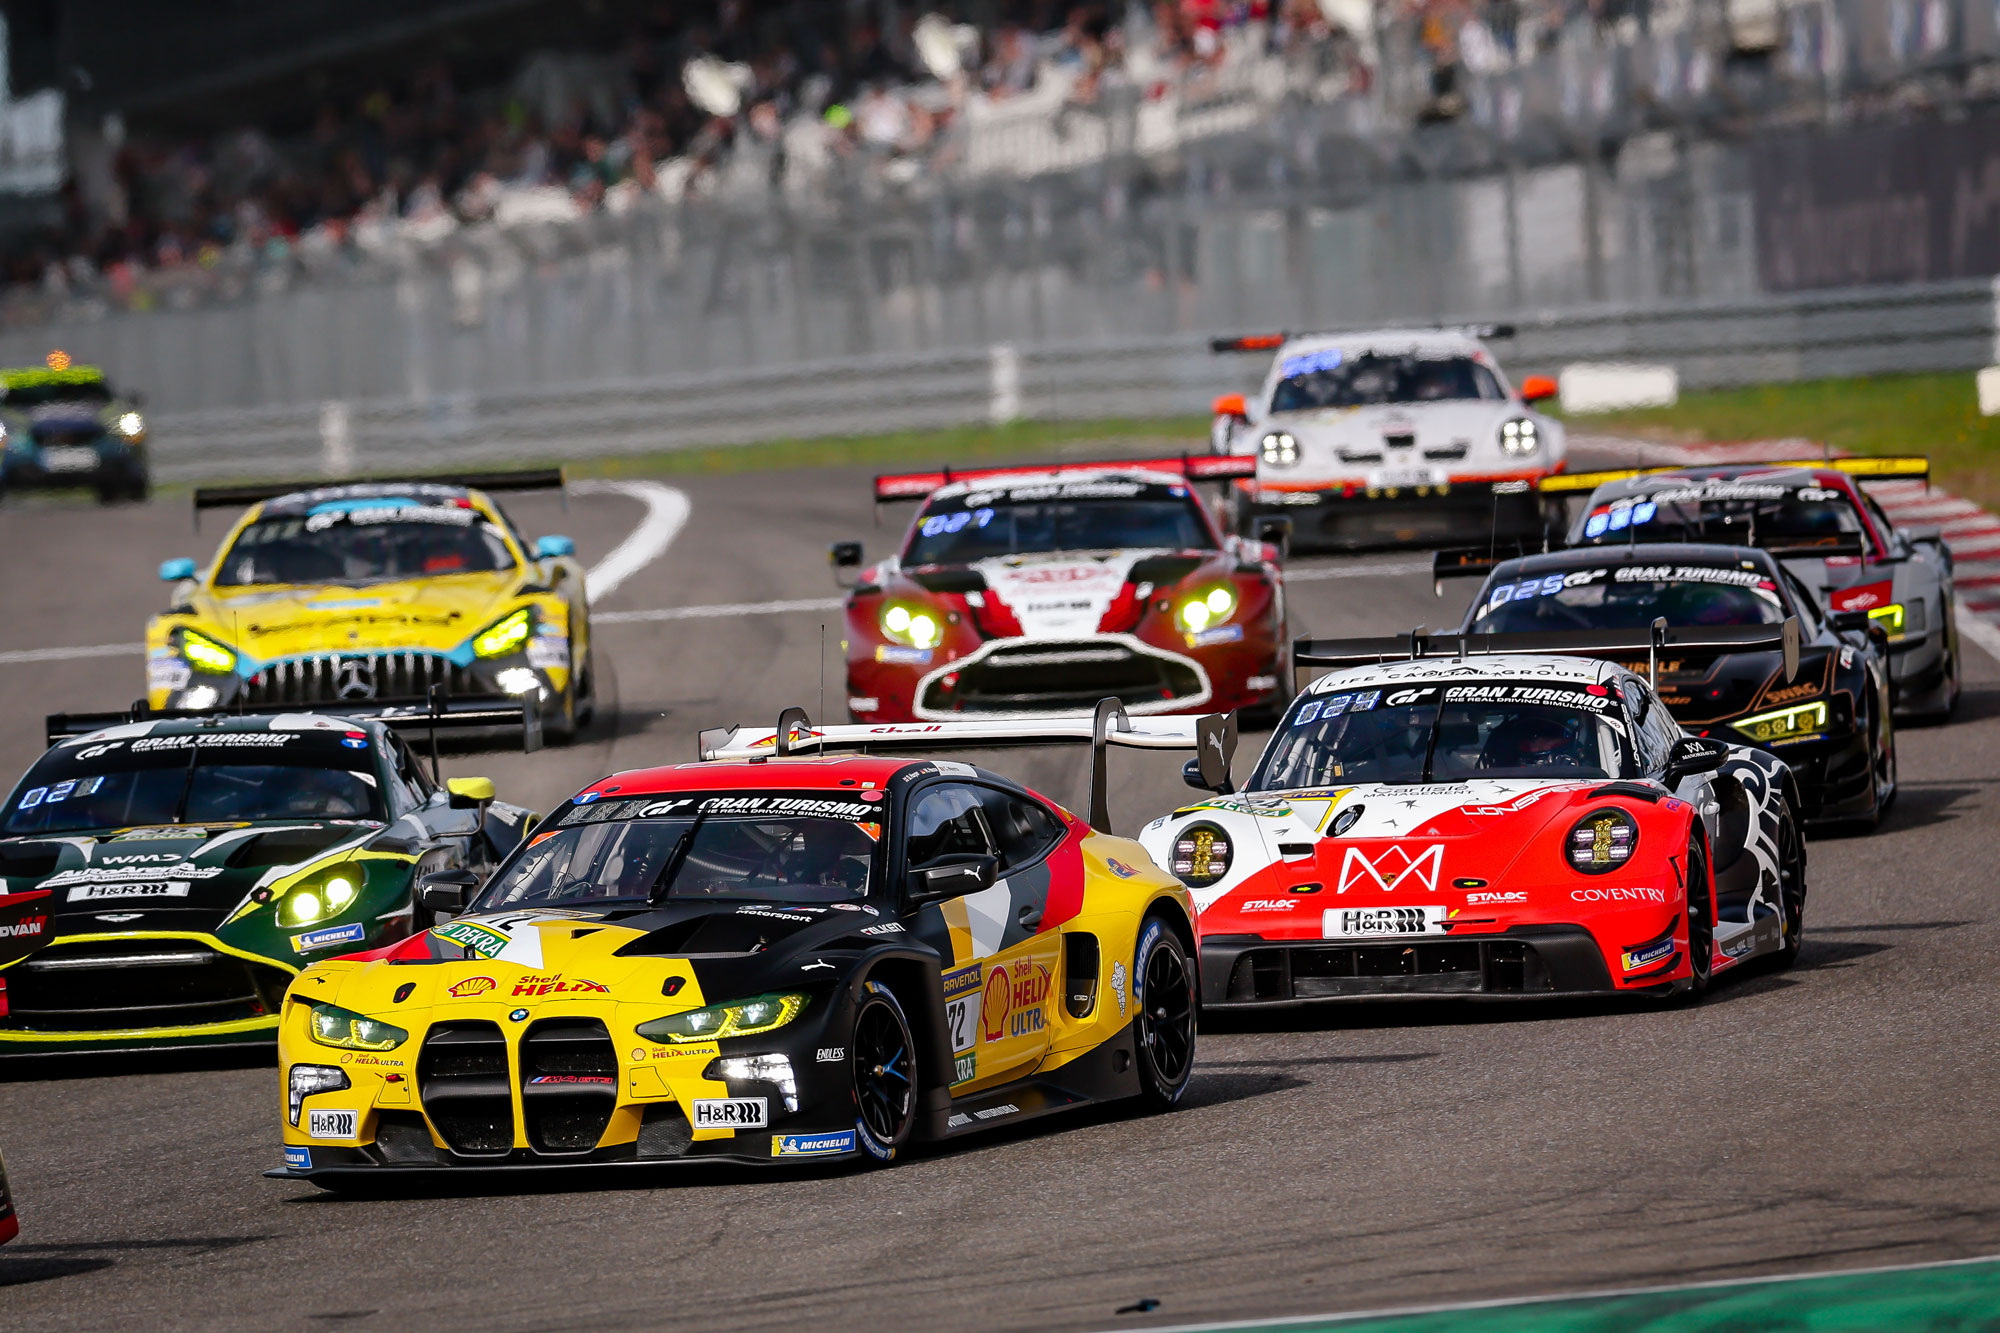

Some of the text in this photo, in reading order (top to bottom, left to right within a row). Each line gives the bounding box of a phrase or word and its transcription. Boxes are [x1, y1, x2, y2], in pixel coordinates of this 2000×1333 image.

[1614, 566, 1672, 580] GRAN
[1675, 566, 1762, 584] TURISMO
[1490, 573, 1566, 606] 025
[1326, 675, 1376, 688] LIFE
[1502, 669, 1587, 678] GROUP
[1445, 686, 1509, 698] GRAN
[1511, 687, 1610, 709] TURISMO
[1294, 690, 1382, 727] 024
[1543, 700, 1603, 714] SIMULATOR
[131, 735, 194, 749] GRAN
[195, 733, 291, 744] TURISMO
[1363, 790, 1475, 799] MANAGEMENT
[1373, 784, 1470, 793] Carlisle
[698, 797, 768, 810] GRAN
[767, 798, 873, 816] TURISMO
[1208, 800, 1281, 818] DEKRA
[796, 811, 862, 821] SIMULATOR
[1466, 891, 1527, 902] STALOC
[1570, 887, 1666, 903] COVENTRY
[1242, 899, 1297, 909] STALOC
[735, 909, 813, 923] Motorsport
[1342, 909, 1395, 934] H&R
[0, 922, 41, 937] DVAN
[313, 929, 357, 942] MICHELIN
[860, 921, 907, 936] FALKEN
[452, 926, 506, 958] DEKRA
[1640, 943, 1672, 961] MICHELIN
[1014, 954, 1032, 980] Shell
[518, 973, 563, 984] Shell
[943, 970, 980, 993] RAVENOL
[1012, 963, 1053, 1010] HELIX
[511, 978, 612, 996] HELIX
[948, 1001, 966, 1048] 72
[355, 1056, 380, 1065] HELIX
[652, 1047, 716, 1060] HELIX ULTRA
[816, 1047, 845, 1061] ENDLESS
[955, 1056, 974, 1081] KRA
[547, 1075, 613, 1084] M4 GT3
[698, 1105, 736, 1123] H&R
[311, 1113, 336, 1132] H&R
[800, 1136, 851, 1150] MICHELIN
[285, 1153, 305, 1163] HELIN
